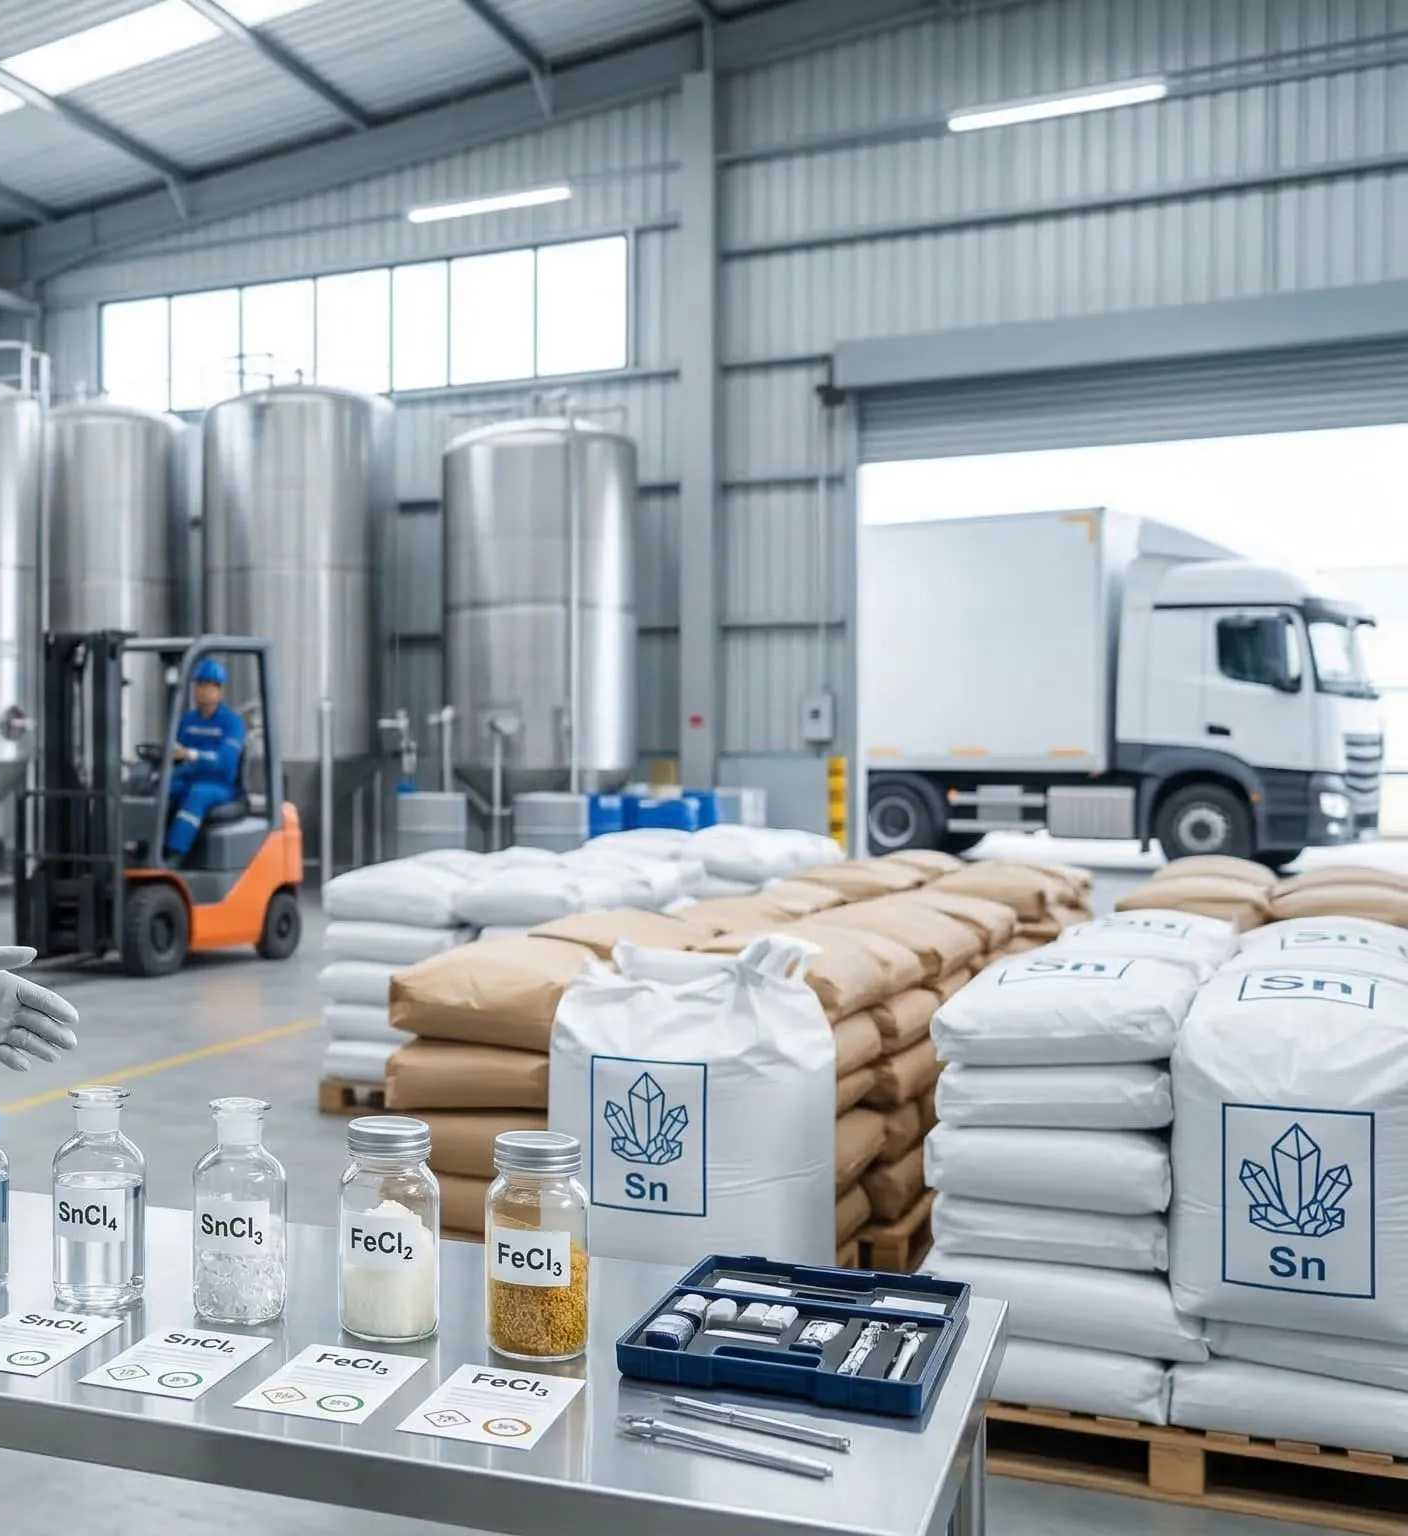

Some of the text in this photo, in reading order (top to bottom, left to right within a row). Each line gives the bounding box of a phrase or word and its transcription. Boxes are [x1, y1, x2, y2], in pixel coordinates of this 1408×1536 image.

[1260, 975, 1352, 995] Sn
[625, 1172, 668, 1202] Sn
[1269, 1246, 1326, 1281] Sn
